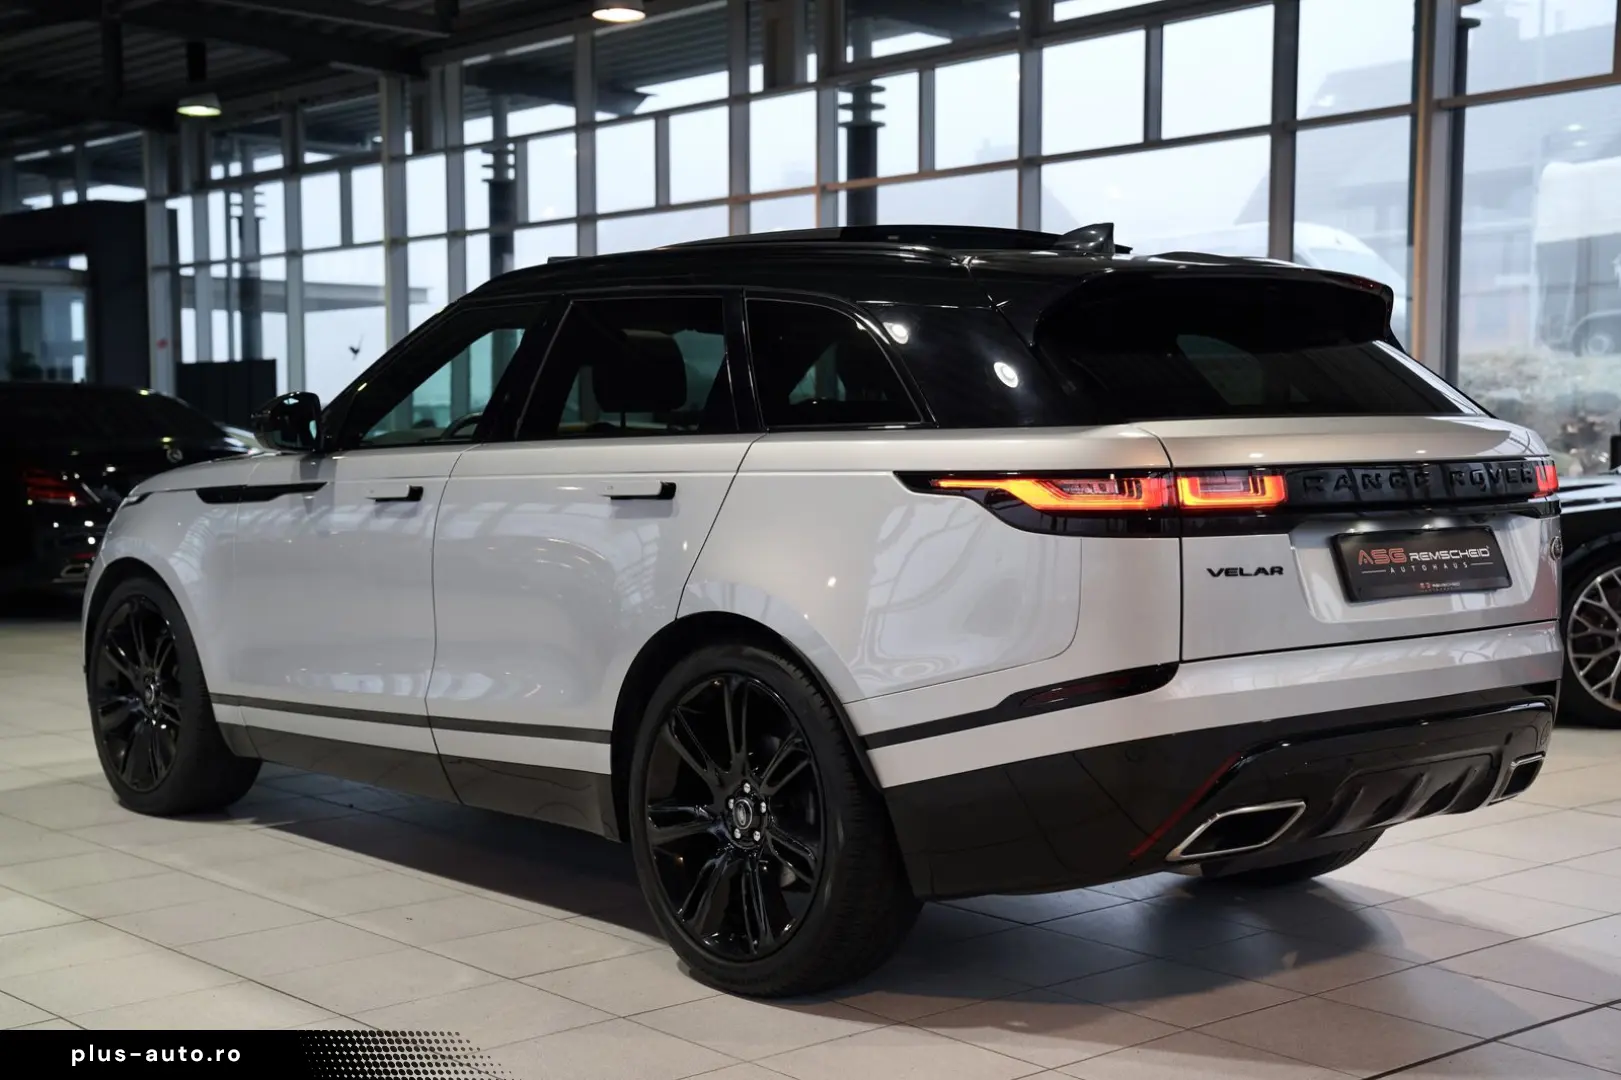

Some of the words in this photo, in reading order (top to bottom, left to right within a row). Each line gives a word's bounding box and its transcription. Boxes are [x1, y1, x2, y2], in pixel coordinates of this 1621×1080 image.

[1303, 472, 1430, 492] RANGE
[1450, 467, 1533, 487] ROVER
[1358, 548, 1407, 566] ASG
[1409, 547, 1490, 562] REMSCHEID
[1206, 566, 1284, 578] VELAR
[1390, 562, 1468, 574] AUTOHAUS
